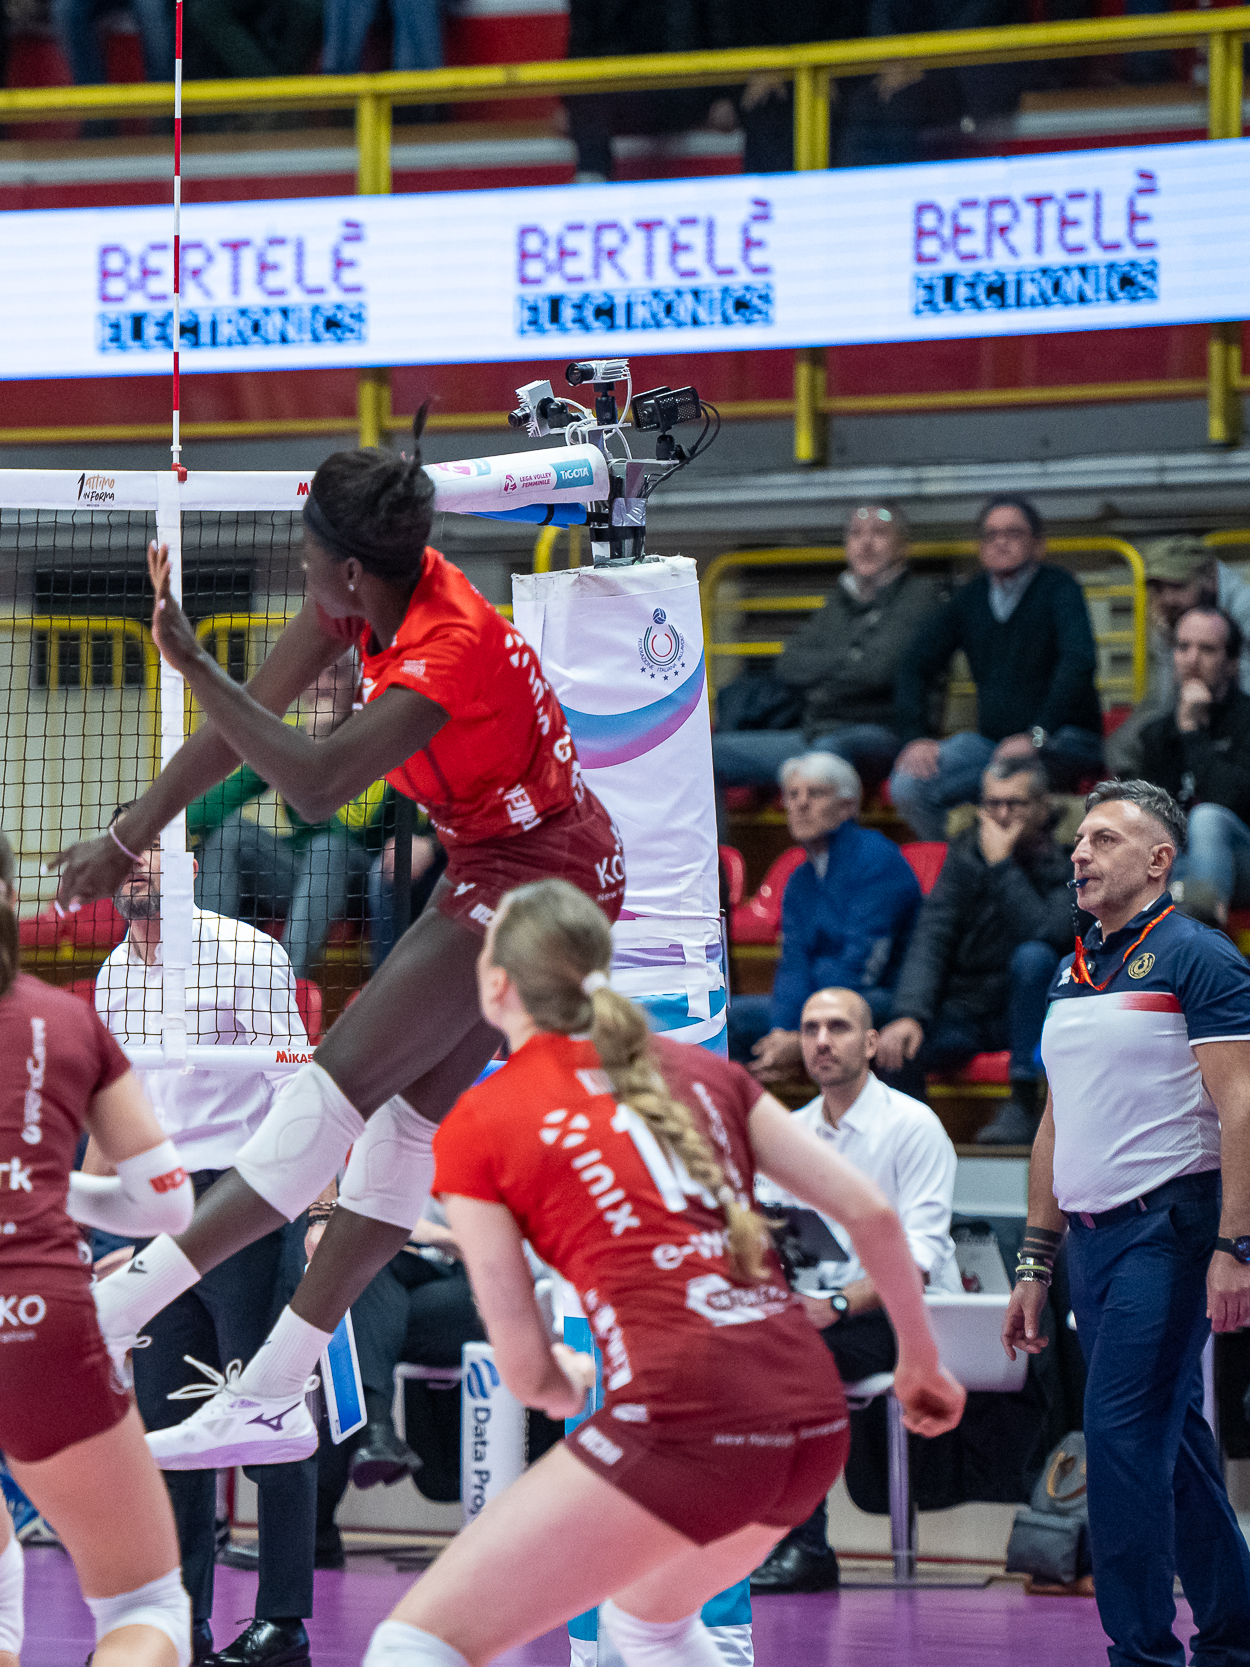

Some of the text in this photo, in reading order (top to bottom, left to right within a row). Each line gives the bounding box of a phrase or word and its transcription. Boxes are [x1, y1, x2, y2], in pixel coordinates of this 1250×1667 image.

[516, 197, 771, 288] BERTELÈ
[914, 168, 1157, 265] BERTELÈ
[97, 217, 364, 304] BERTELÈ
[913, 258, 1158, 316] ELECTRONICS
[96, 303, 365, 354] ELECTRONICS
[517, 282, 774, 337] ELECTRONICS
[519, 472, 551, 482] LEGA VOLLEY
[521, 479, 550, 488] FEMMINILE
[276, 1048, 313, 1064] MIKAS
[572, 1149, 642, 1237] inix
[474, 1407, 492, 1462] Data
